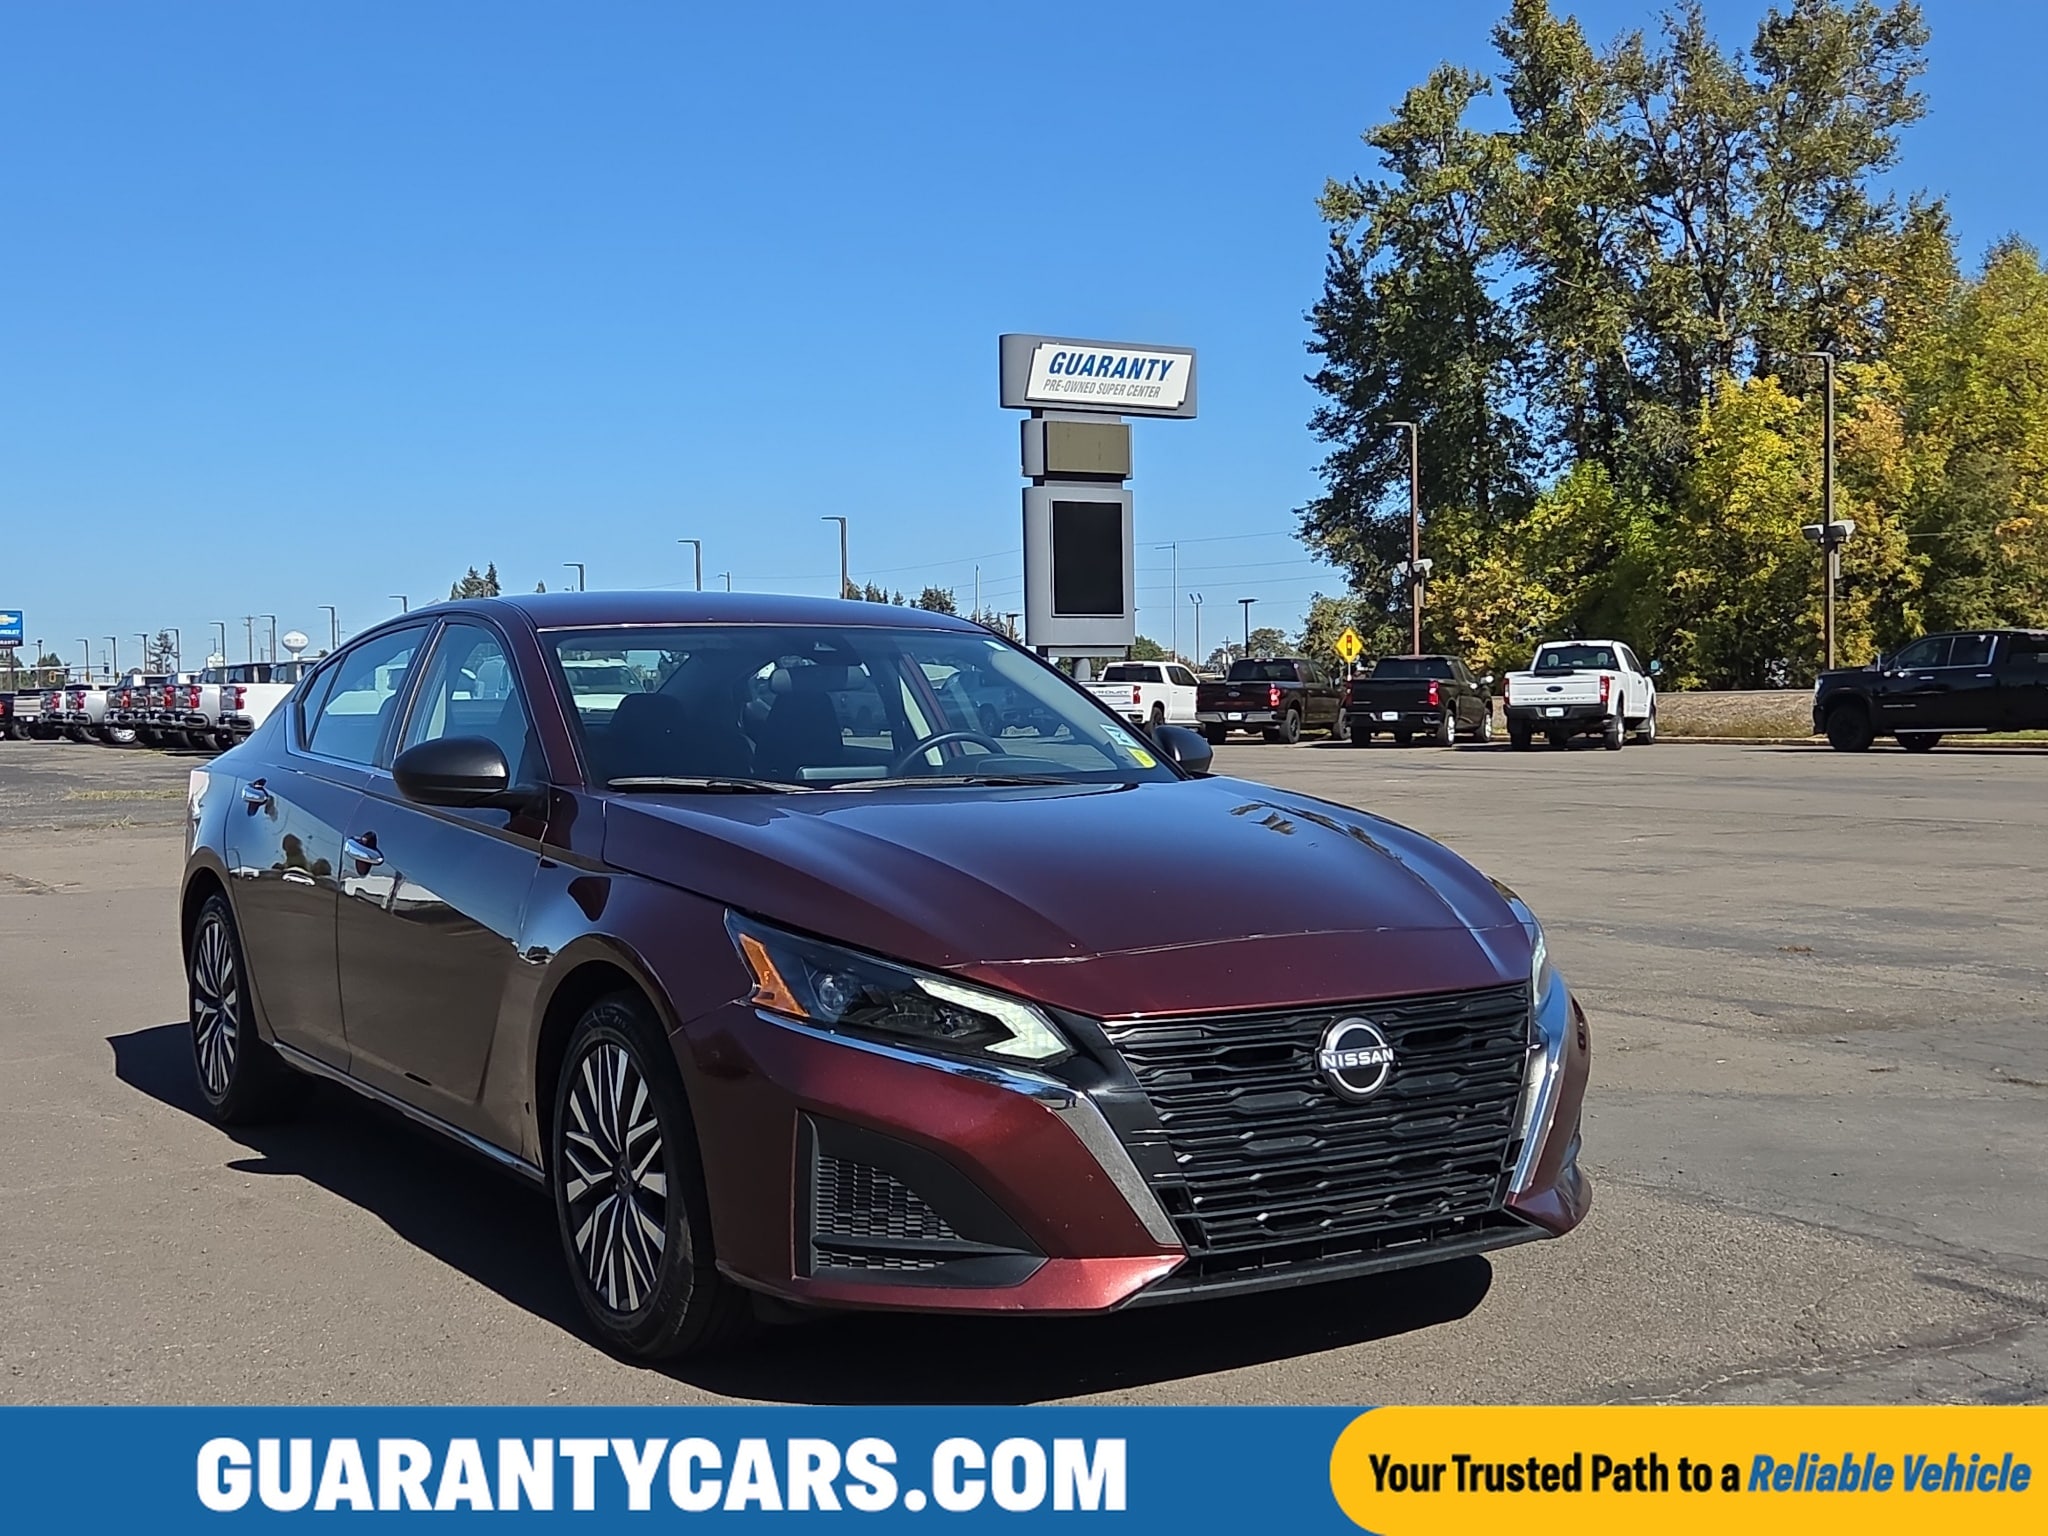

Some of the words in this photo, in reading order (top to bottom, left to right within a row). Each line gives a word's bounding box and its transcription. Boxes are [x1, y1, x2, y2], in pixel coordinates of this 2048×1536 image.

[1048, 351, 1175, 382] GUARANTY
[1043, 379, 1096, 394] PRE-OWNED
[1096, 382, 1126, 396] SUPER
[1126, 384, 1161, 398] CENTER
[1320, 1048, 1394, 1069] NISSAN
